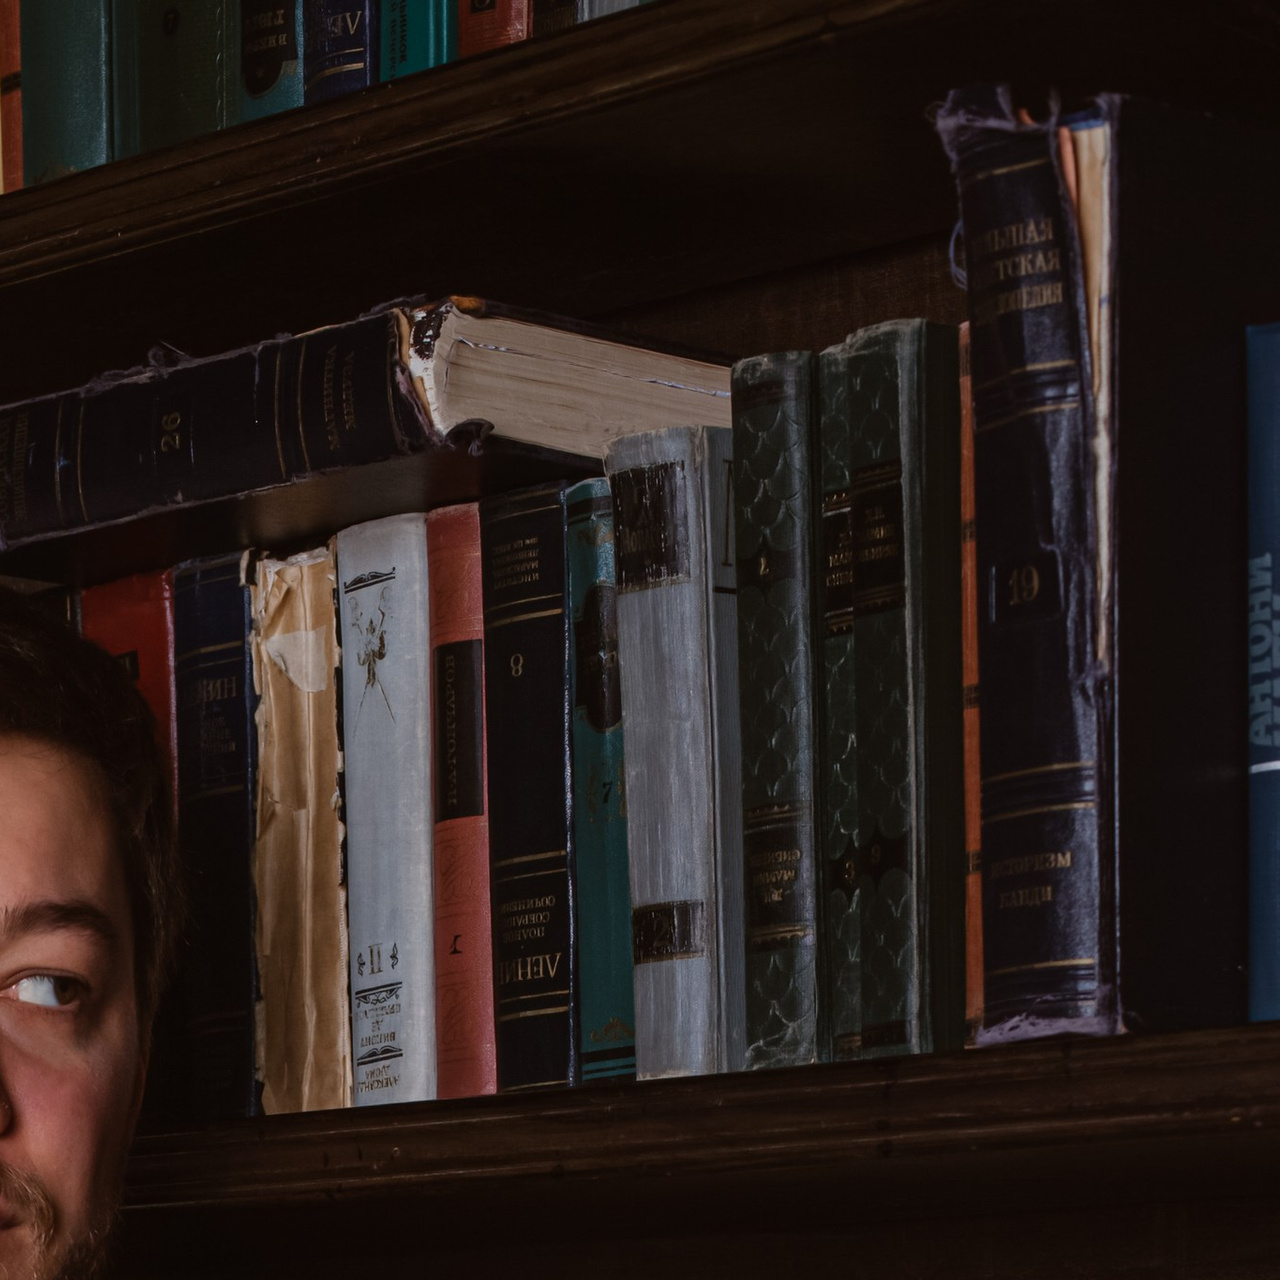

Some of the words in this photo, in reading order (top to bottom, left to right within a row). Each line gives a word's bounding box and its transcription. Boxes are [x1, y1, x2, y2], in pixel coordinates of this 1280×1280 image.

[161, 411, 181, 452] 26
[1008, 565, 1040, 606] 19
[510, 653, 524, 677] 8
[1248, 552, 1272, 748] АНТОНИ
[602, 781, 613, 804] 7
